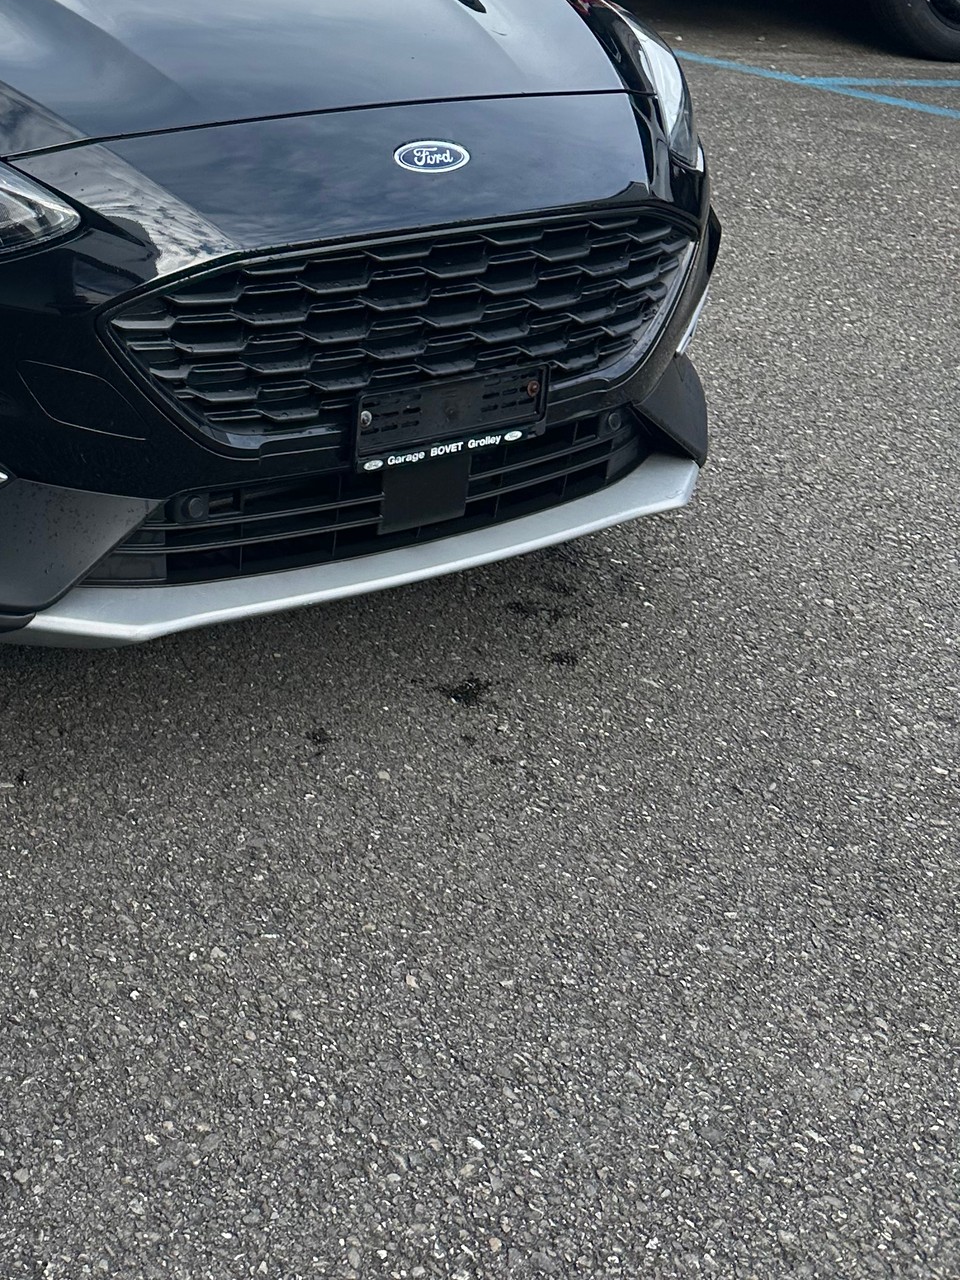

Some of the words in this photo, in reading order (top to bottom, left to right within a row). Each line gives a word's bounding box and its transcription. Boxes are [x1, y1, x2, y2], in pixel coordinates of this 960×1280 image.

[413, 147, 453, 166] Ford
[387, 451, 425, 465] Garage
[430, 442, 463, 457] BOVET
[468, 435, 501, 449] Grolley
